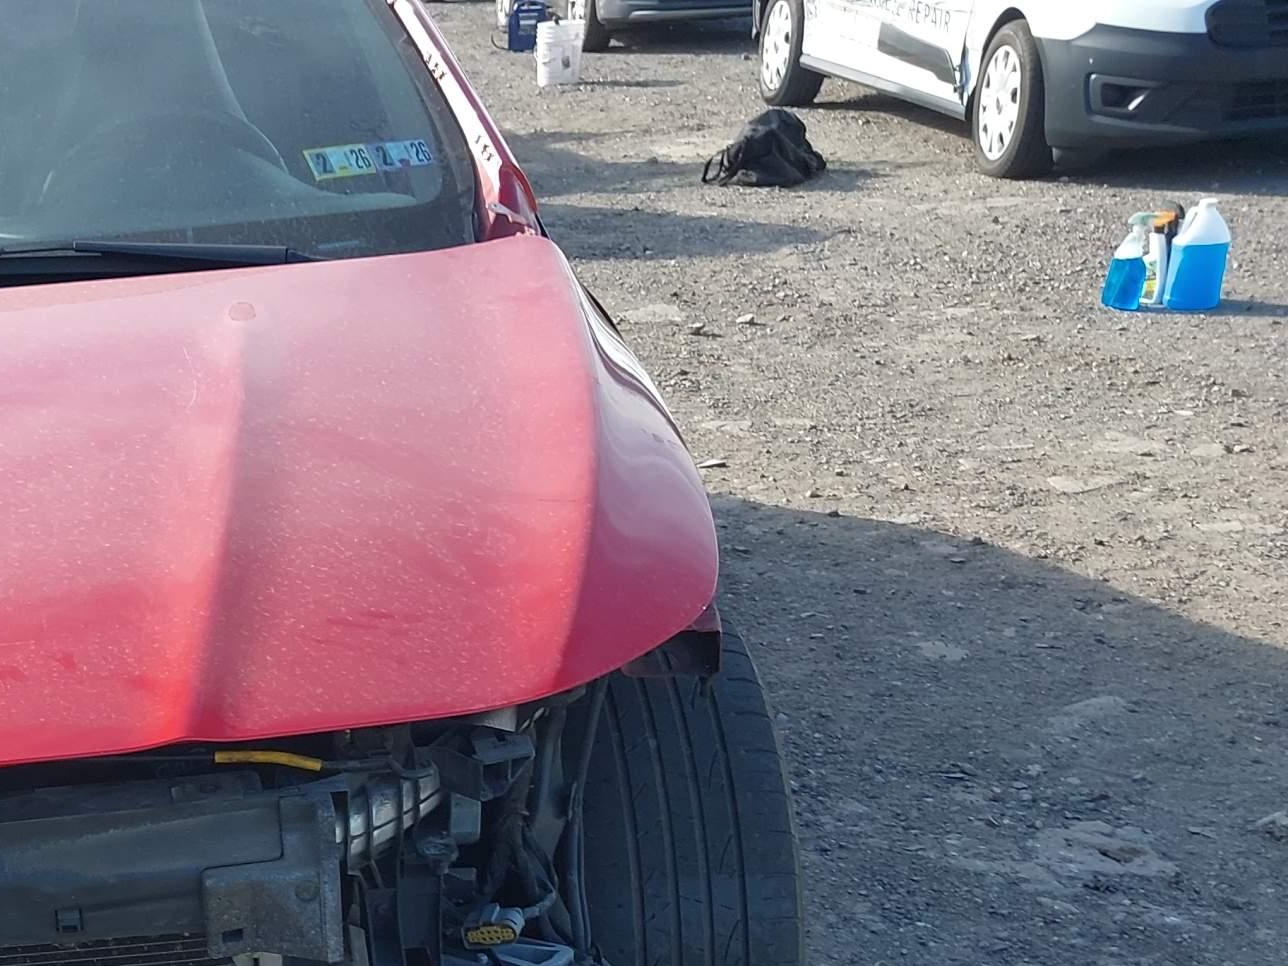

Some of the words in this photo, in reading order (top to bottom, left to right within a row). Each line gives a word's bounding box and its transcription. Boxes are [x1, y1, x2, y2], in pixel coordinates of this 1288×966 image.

[909, 0, 951, 32] REPAIR
[317, 152, 334, 174] 2
[350, 148, 372, 169] 26
[376, 145, 394, 167] 2
[410, 140, 432, 162] 26
